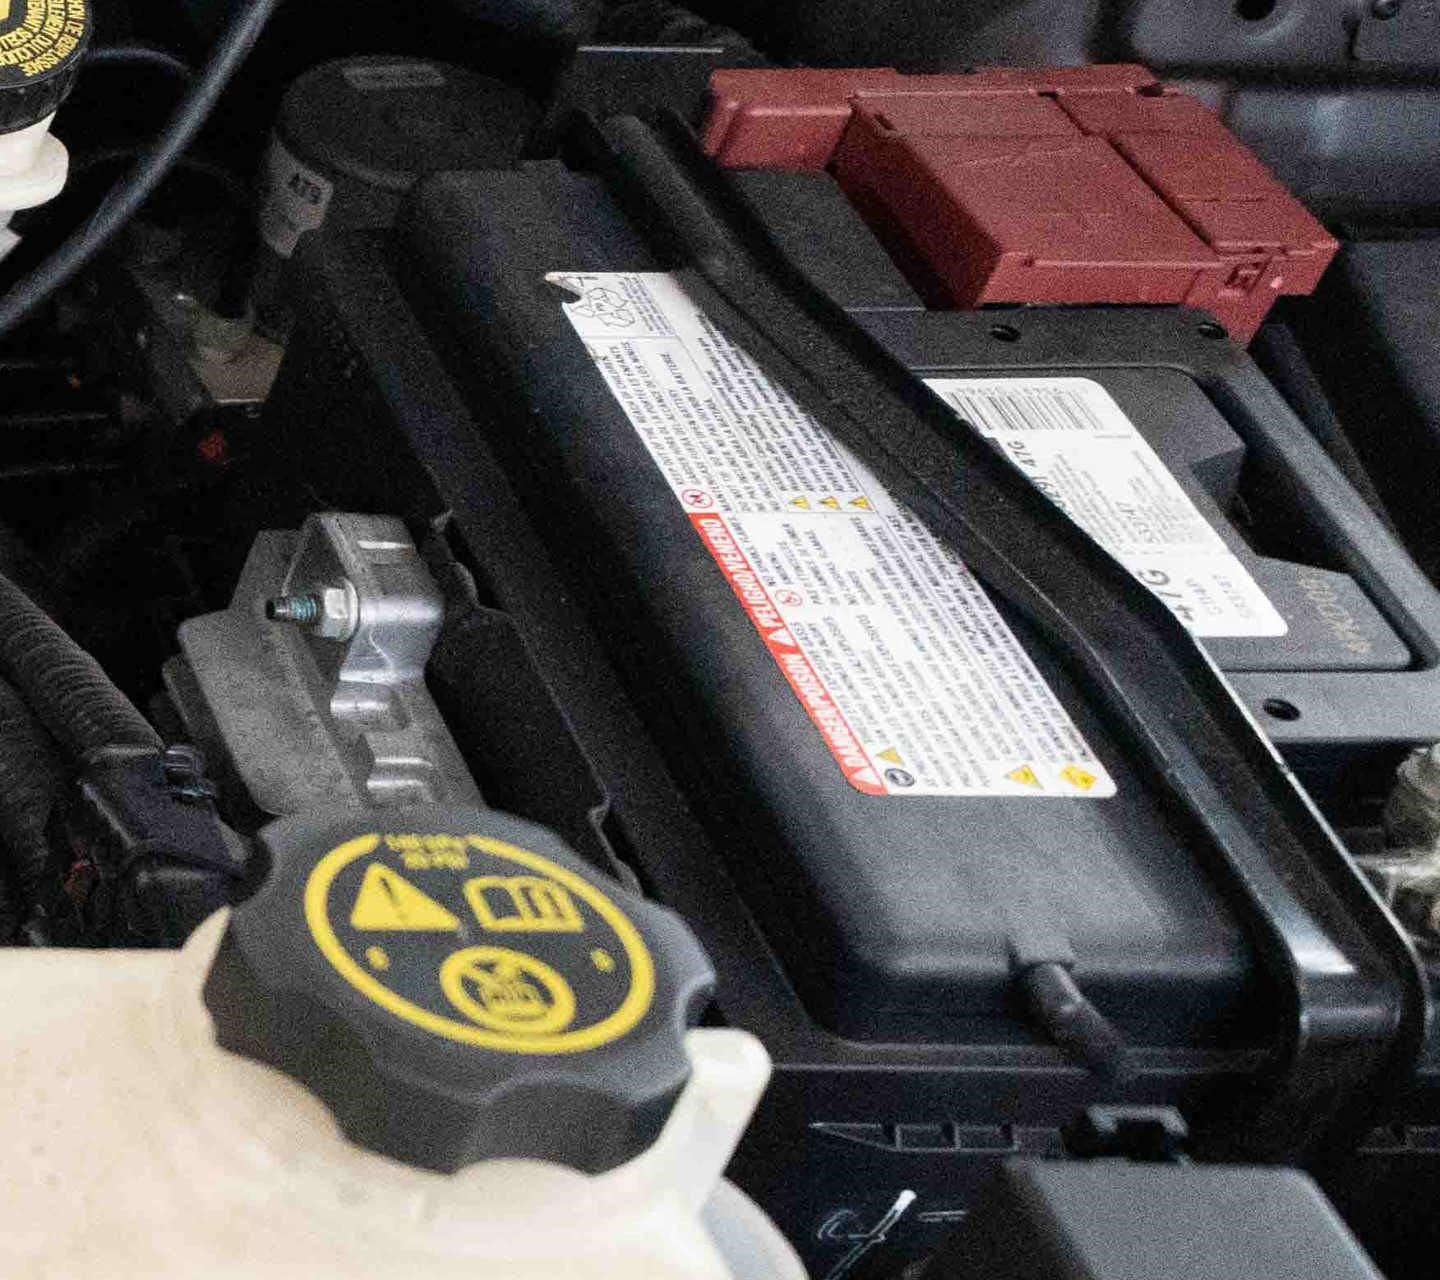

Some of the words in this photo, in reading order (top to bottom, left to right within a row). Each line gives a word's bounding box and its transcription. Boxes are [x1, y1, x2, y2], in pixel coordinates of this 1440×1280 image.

[17, 32, 80, 78] REMPLISSAGE
[63, 19, 85, 38] DE
[695, 517, 784, 626] PELIGRO/VENENO
[777, 653, 869, 768] DANGER/POISON
